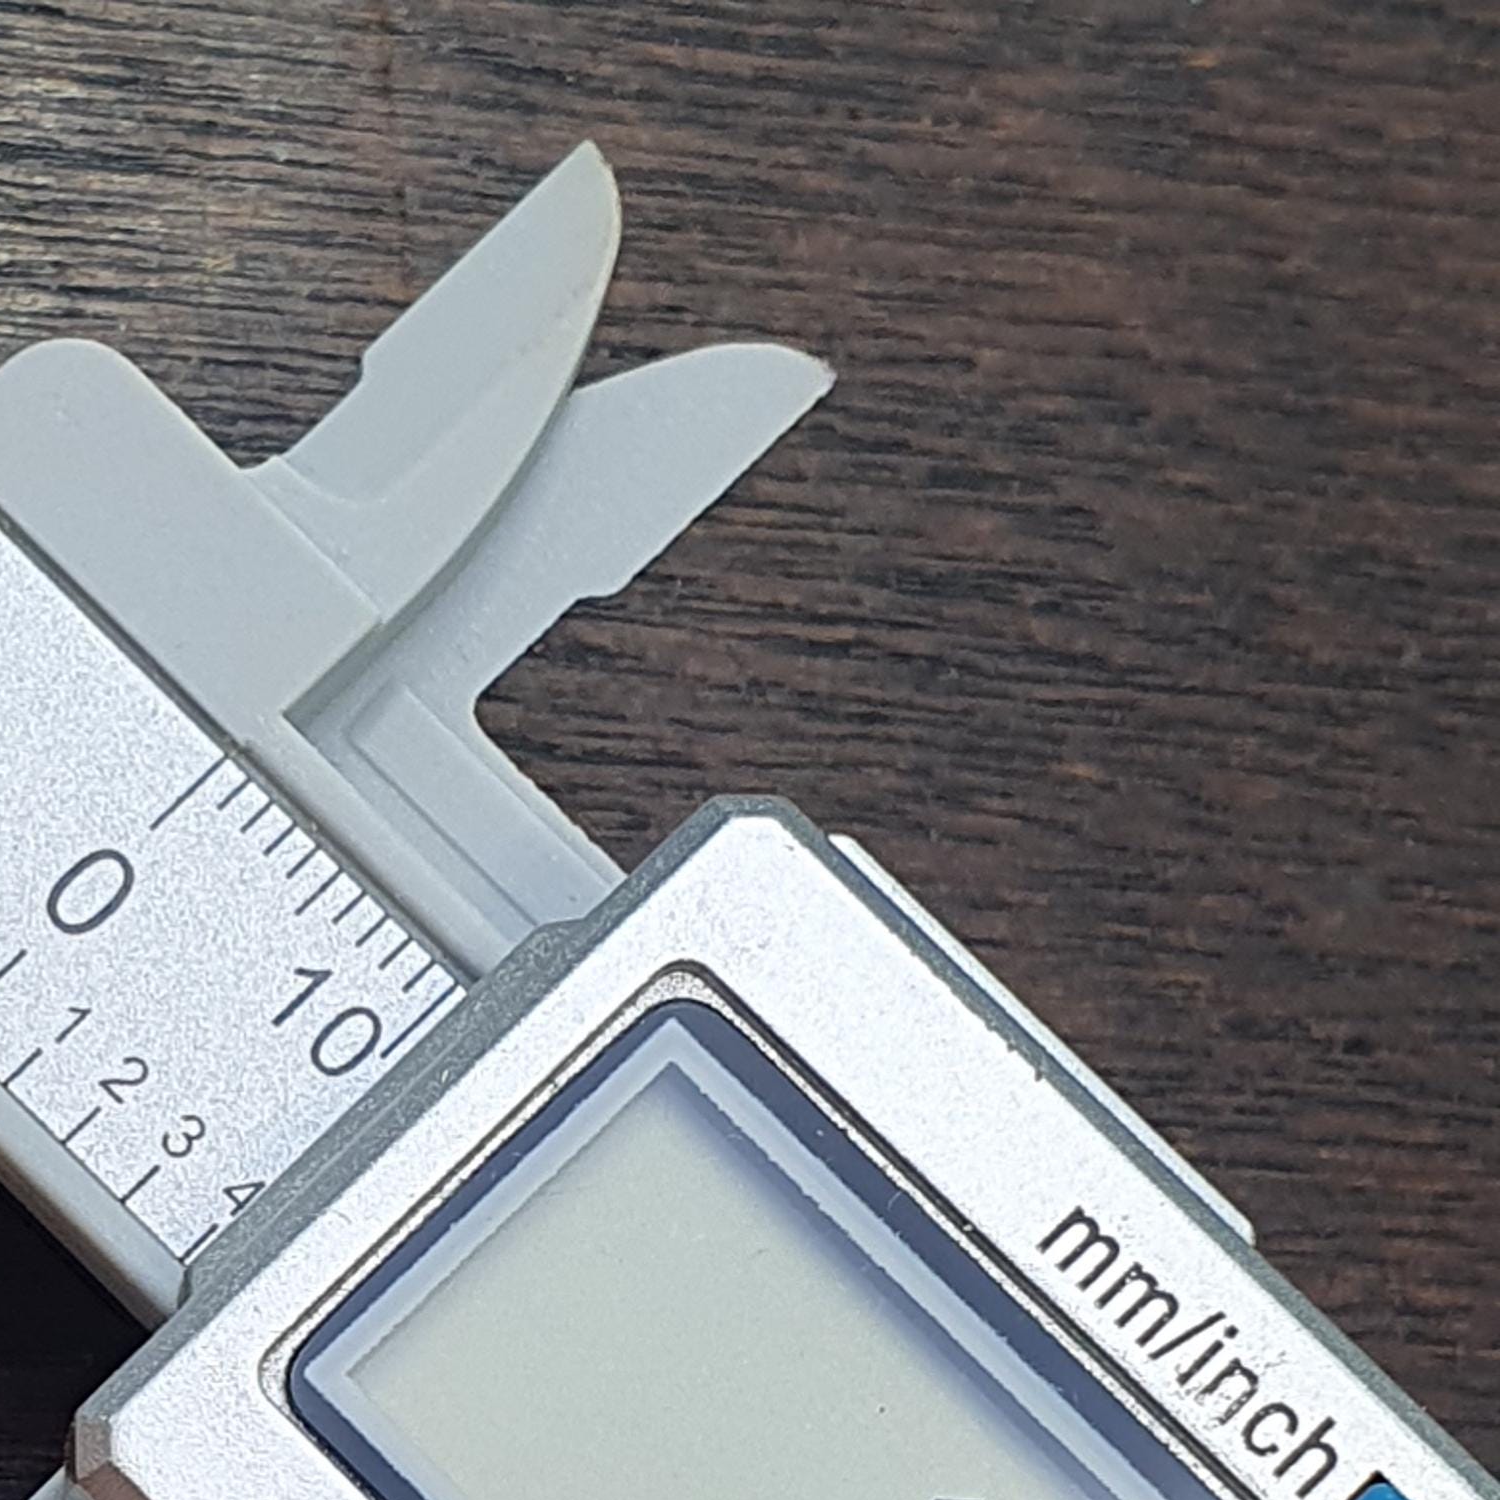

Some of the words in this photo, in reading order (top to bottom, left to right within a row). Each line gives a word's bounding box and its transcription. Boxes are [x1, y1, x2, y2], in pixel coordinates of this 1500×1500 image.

[46, 848, 135, 935] 0
[271, 966, 382, 1077] 10
[55, 1006, 92, 1044] 1
[99, 1056, 149, 1104] 2
[161, 1113, 206, 1159] 3
[222, 1178, 266, 1217] 4
[1035, 1205, 1339, 1500] mm/inch
